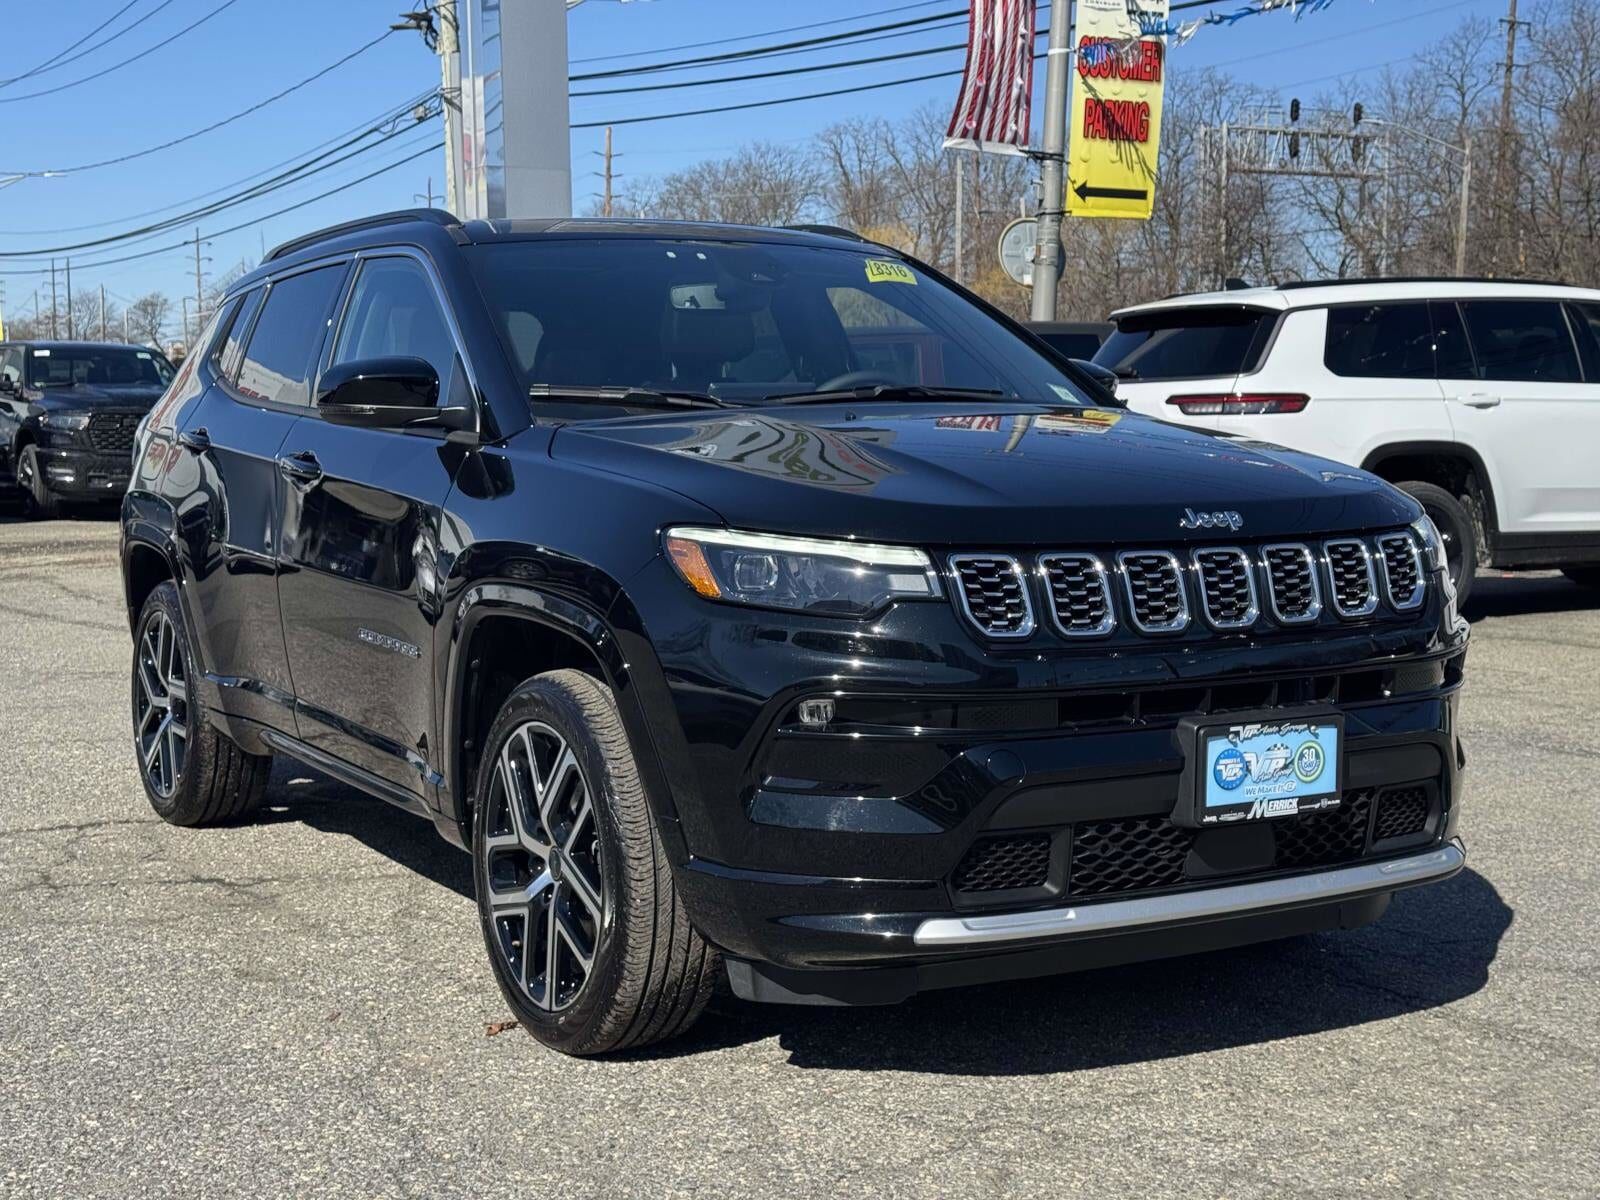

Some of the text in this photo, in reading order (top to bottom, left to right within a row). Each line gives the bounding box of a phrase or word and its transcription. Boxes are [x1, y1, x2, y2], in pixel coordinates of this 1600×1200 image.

[1083, 98, 1150, 143] PARKING
[1180, 507, 1244, 531] Jeep
[1243, 749, 1292, 782] VIP
[1303, 748, 1316, 761] 30
[1247, 797, 1299, 820] MERRICK
